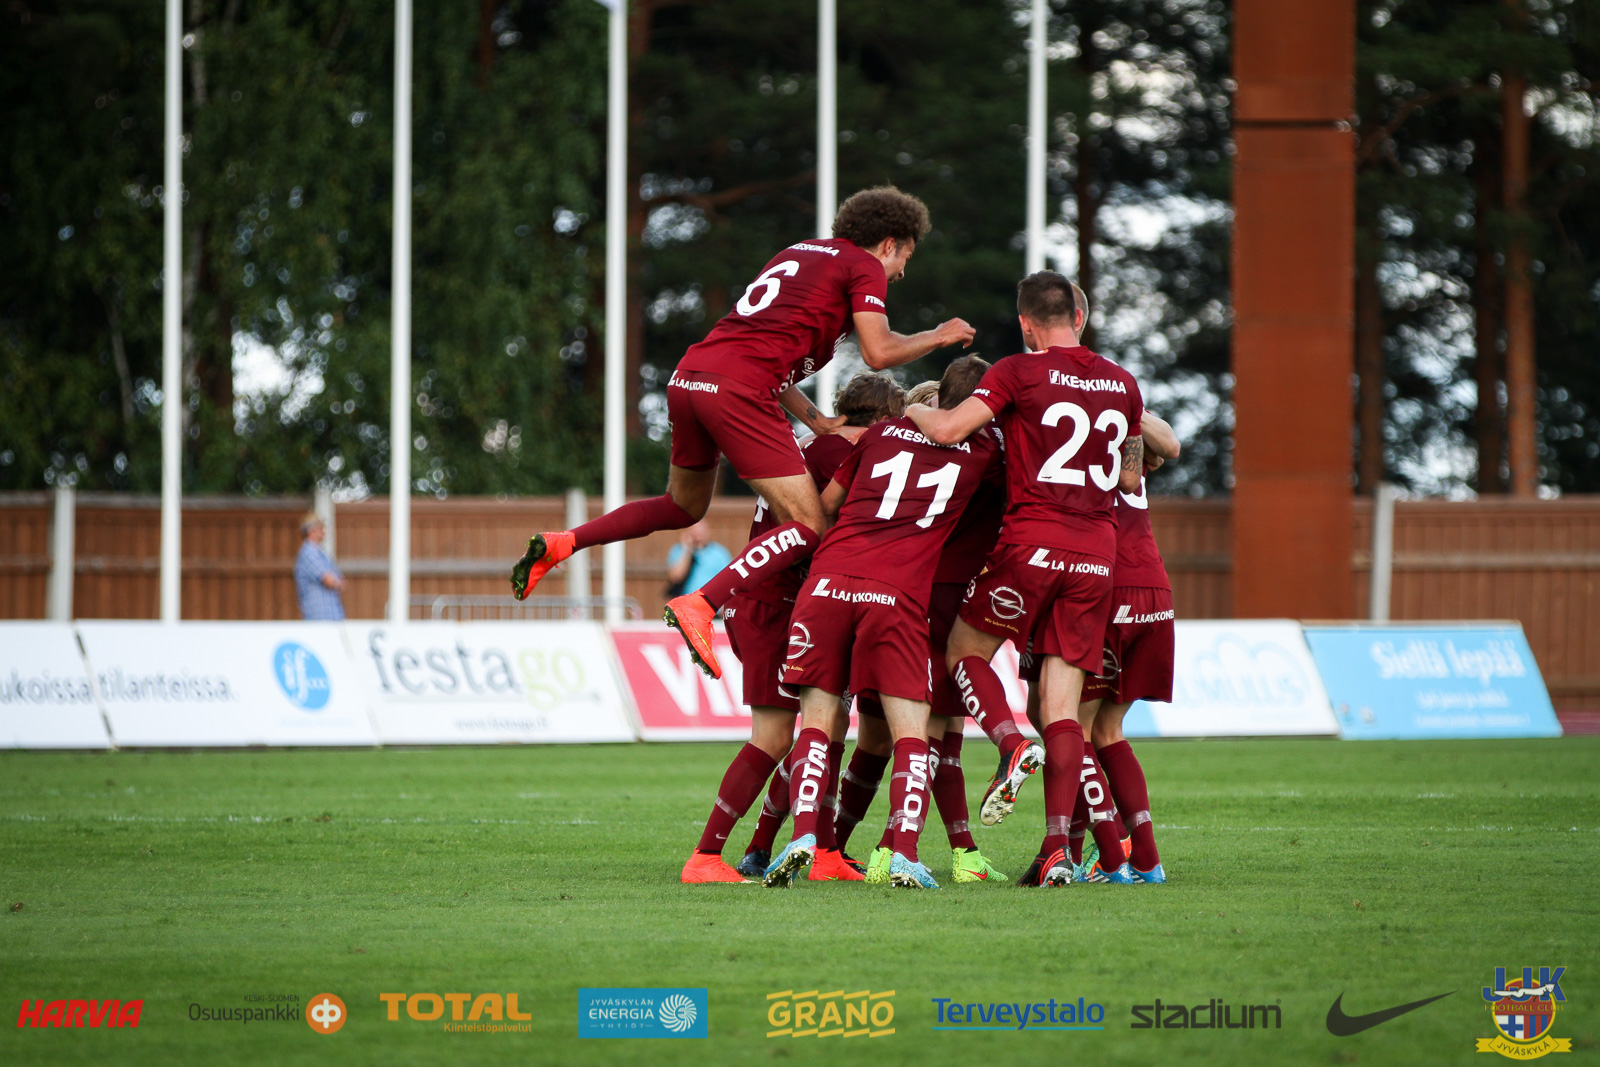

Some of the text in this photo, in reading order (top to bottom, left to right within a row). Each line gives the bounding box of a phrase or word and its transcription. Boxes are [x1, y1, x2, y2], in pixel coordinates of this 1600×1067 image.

[736, 260, 800, 317] 6
[1061, 374, 1127, 394] KESKIMAA
[1037, 402, 1128, 492] 23
[871, 450, 961, 529] 11
[729, 527, 807, 579] TOTAL
[367, 629, 587, 710] festago
[954, 661, 987, 728] TOTAL
[1371, 640, 1527, 689] Siellä lepää
[795, 741, 829, 816] TOTAL
[900, 753, 928, 833] TOTAL
